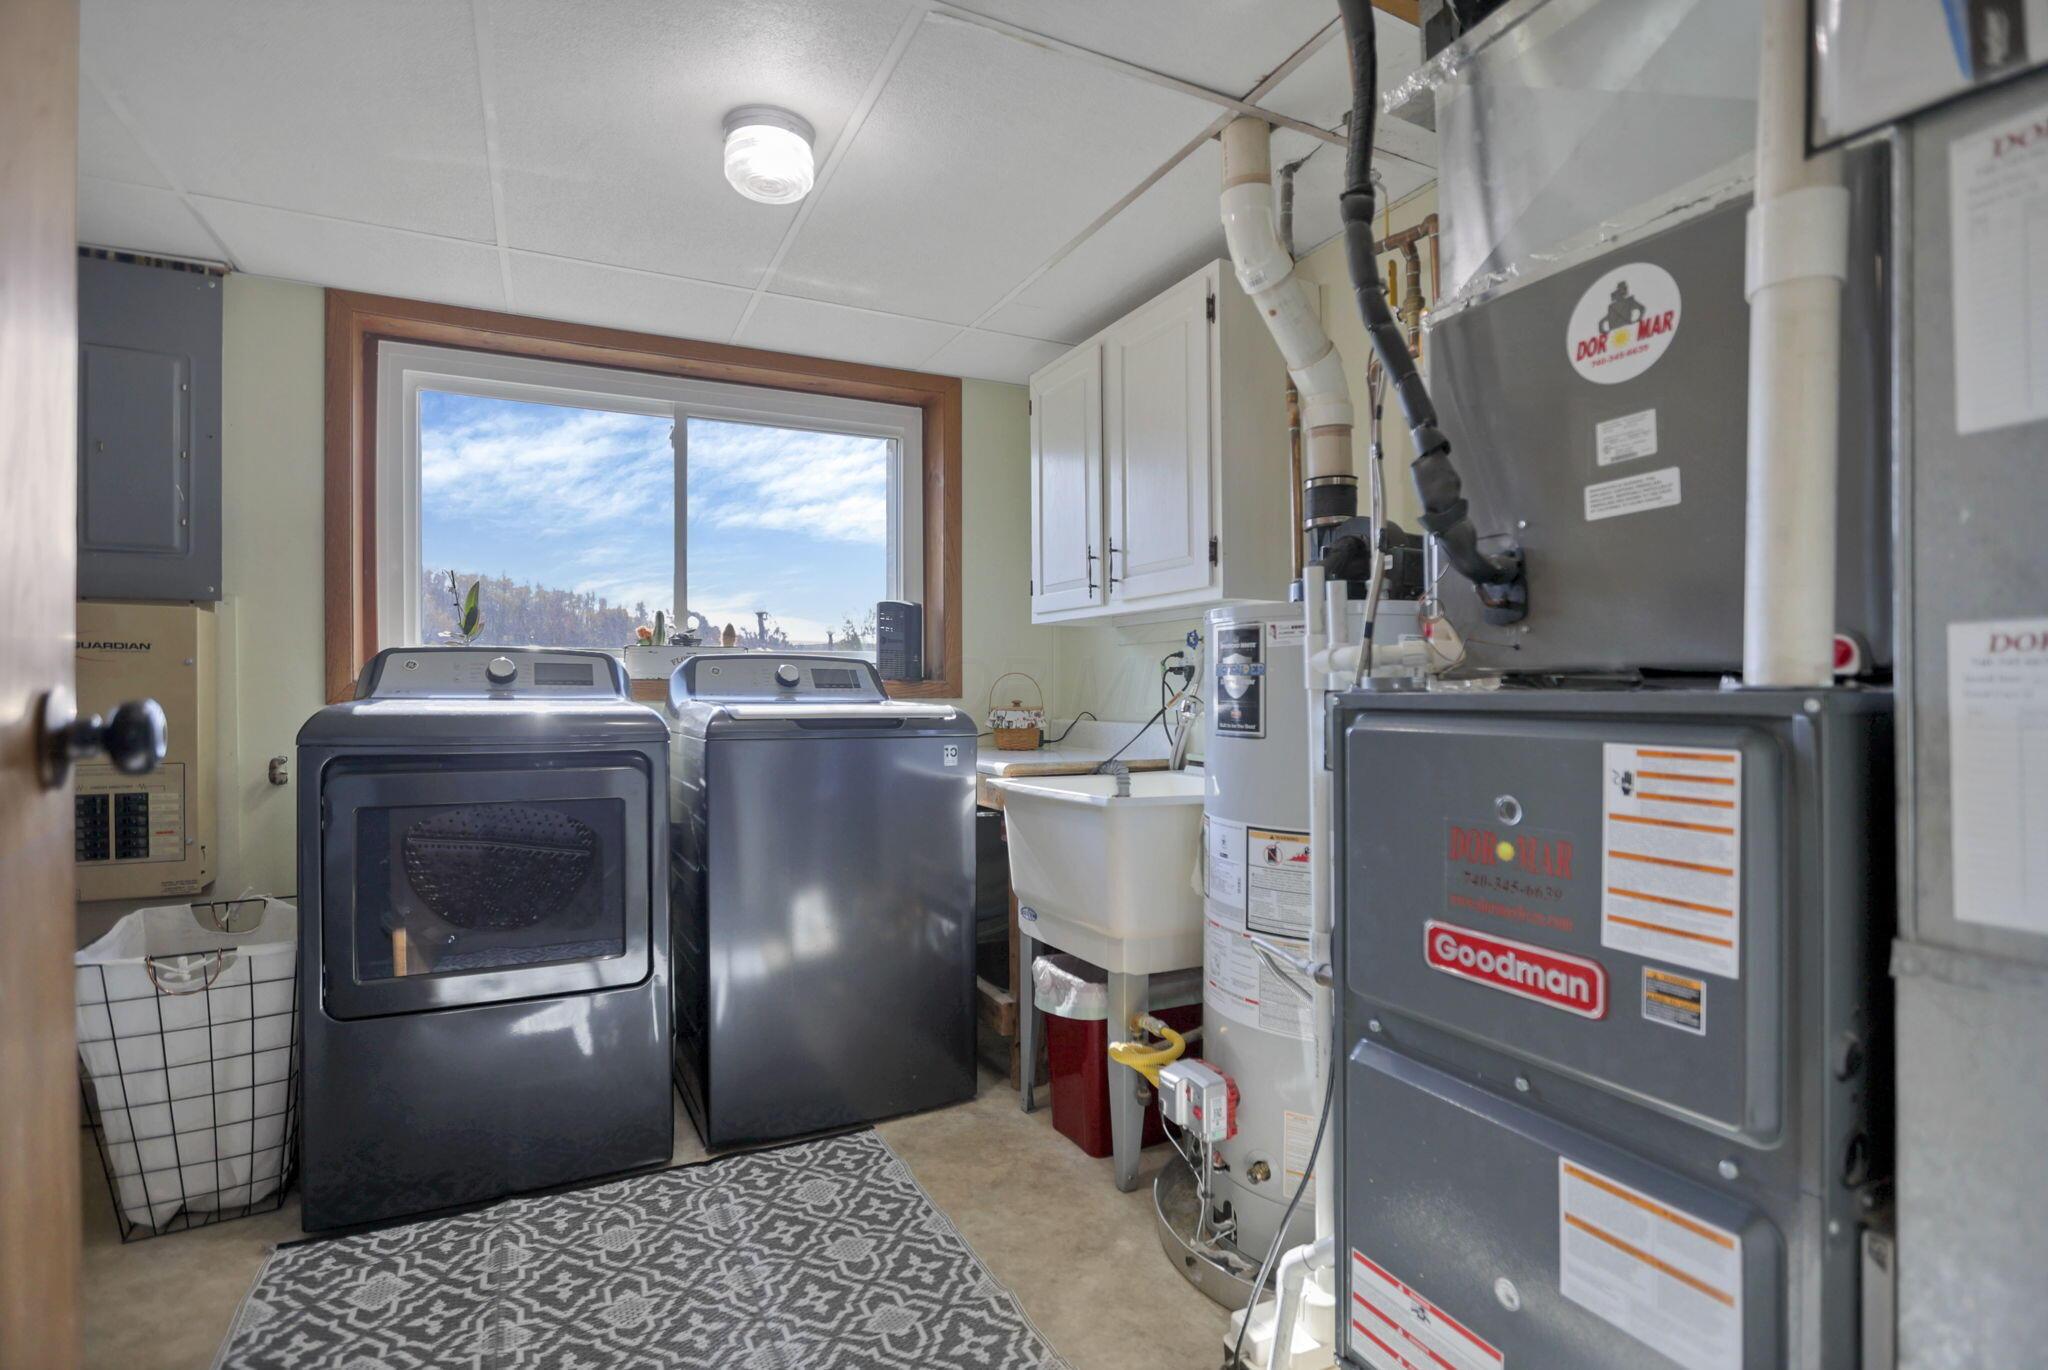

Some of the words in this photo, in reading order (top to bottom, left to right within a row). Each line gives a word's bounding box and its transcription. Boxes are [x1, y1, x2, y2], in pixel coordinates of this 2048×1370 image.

[1993, 122, 2048, 160] DO
[1576, 333, 1608, 362] DOR
[1637, 309, 1675, 341] MAR
[1449, 826, 1498, 865] DOR
[1516, 836, 1574, 881] MAR
[1435, 933, 1591, 1004] Goodman
